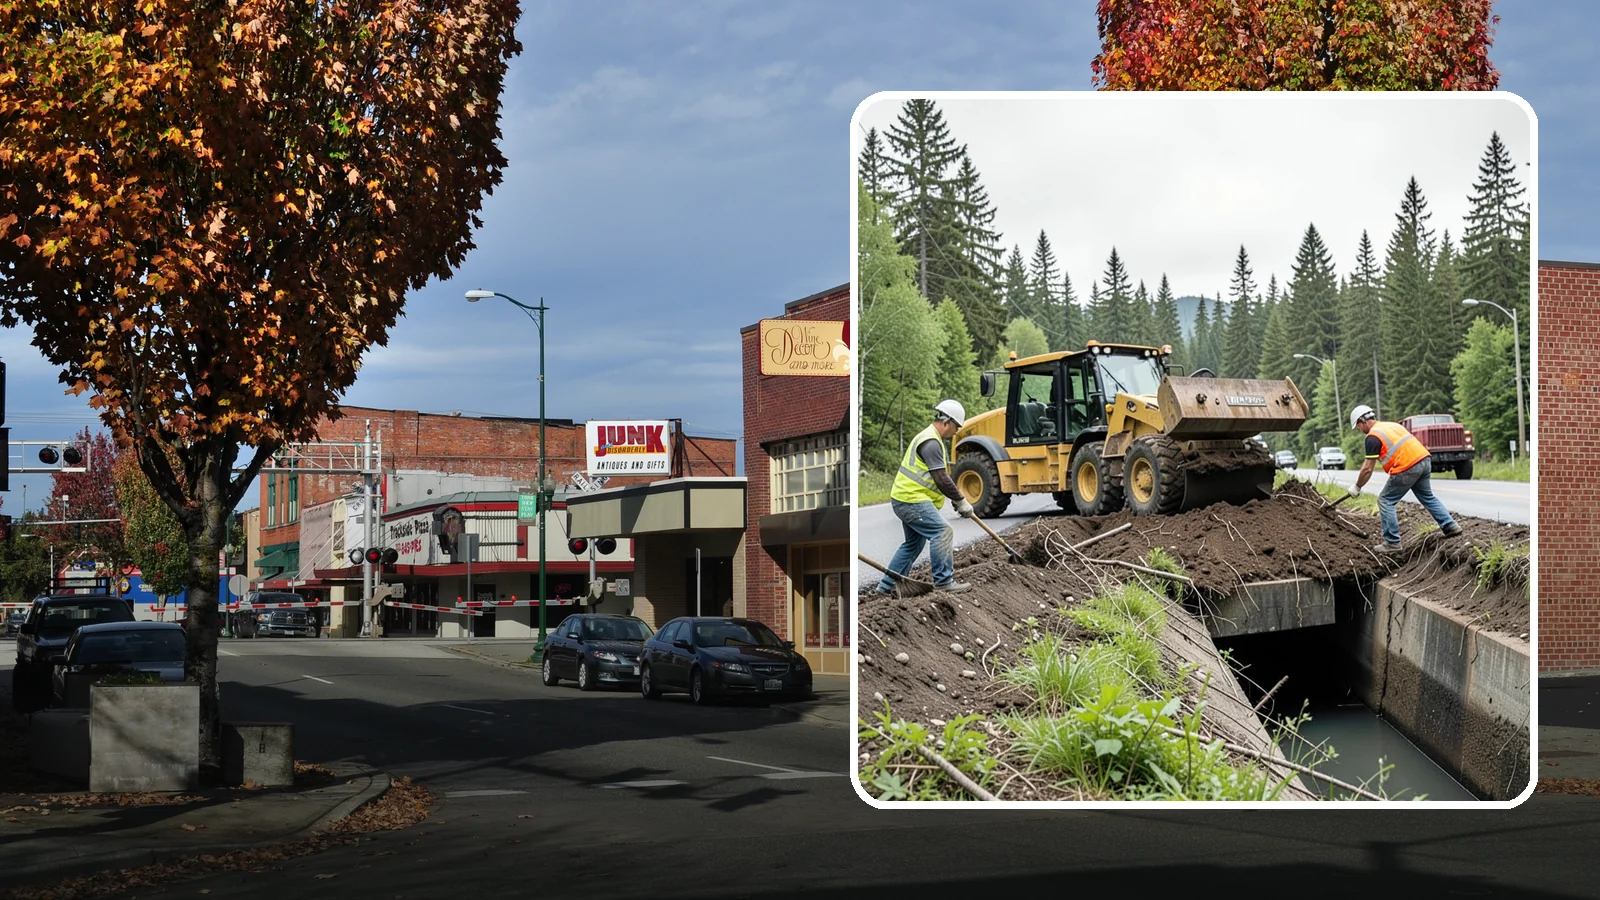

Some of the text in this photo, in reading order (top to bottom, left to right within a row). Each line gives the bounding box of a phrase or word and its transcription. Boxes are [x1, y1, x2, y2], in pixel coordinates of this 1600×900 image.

[765, 327, 831, 365] Decor
[595, 425, 665, 457] JUNK
[607, 446, 646, 454] DISORDERLY
[597, 461, 665, 470] ANTIQUES AND GIFTS
[573, 473, 588, 490] RAIL
[390, 519, 429, 539] Trackside Pizza
